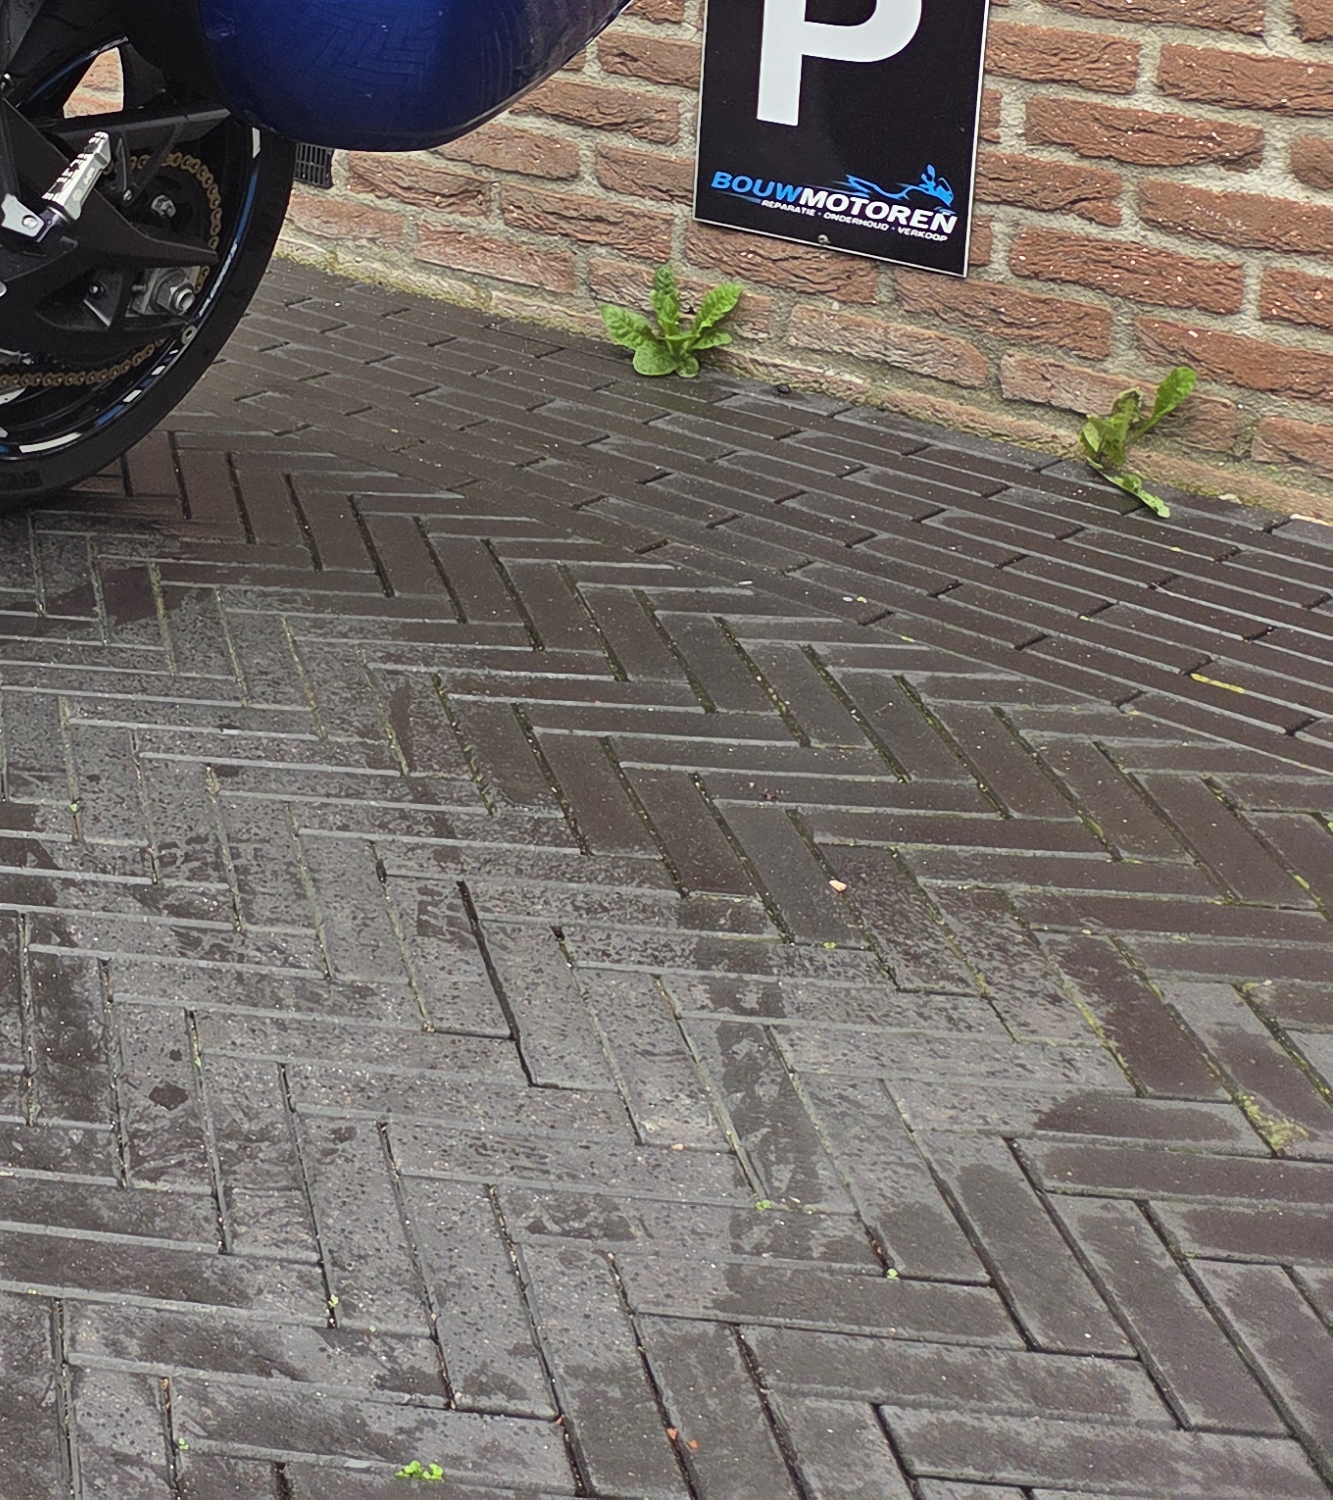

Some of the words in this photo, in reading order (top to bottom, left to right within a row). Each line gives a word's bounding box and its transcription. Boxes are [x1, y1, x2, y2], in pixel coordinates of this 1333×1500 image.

[711, 171, 958, 234] BOUWMOTOREN
[761, 200, 816, 217] REPARATIE
[823, 212, 889, 231] ONDERHOUD
[897, 226, 948, 242] VERKOOP
